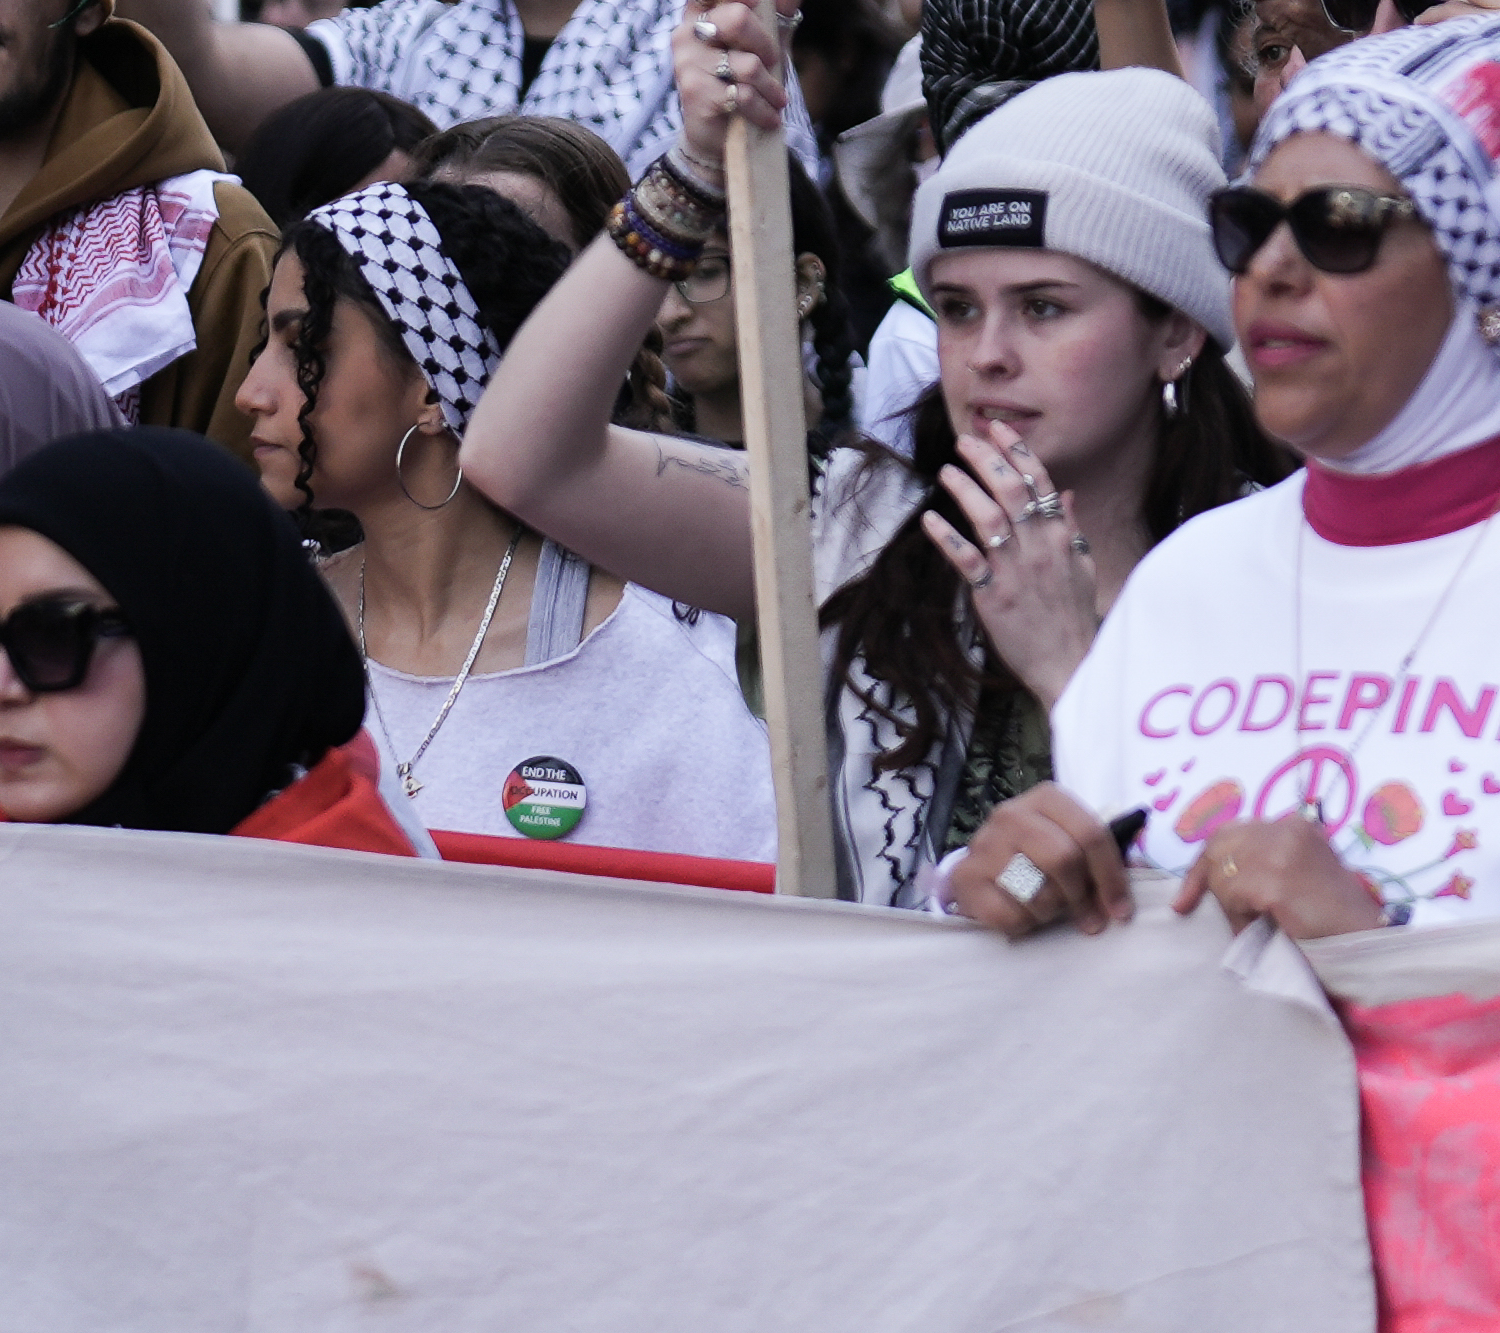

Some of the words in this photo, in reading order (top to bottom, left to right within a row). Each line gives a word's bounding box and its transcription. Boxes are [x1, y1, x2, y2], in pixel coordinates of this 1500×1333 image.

[951, 207, 977, 218] YOU
[980, 203, 1005, 215] ARE
[1009, 200, 1032, 213] ON
[947, 216, 990, 232] NATIVE
[993, 213, 1032, 226] LAND
[521, 765, 545, 778] END
[546, 767, 566, 780] THE
[510, 785, 578, 801] OCCUPATION
[531, 806, 551, 815] FREE
[520, 815, 561, 827] PALESTINE
